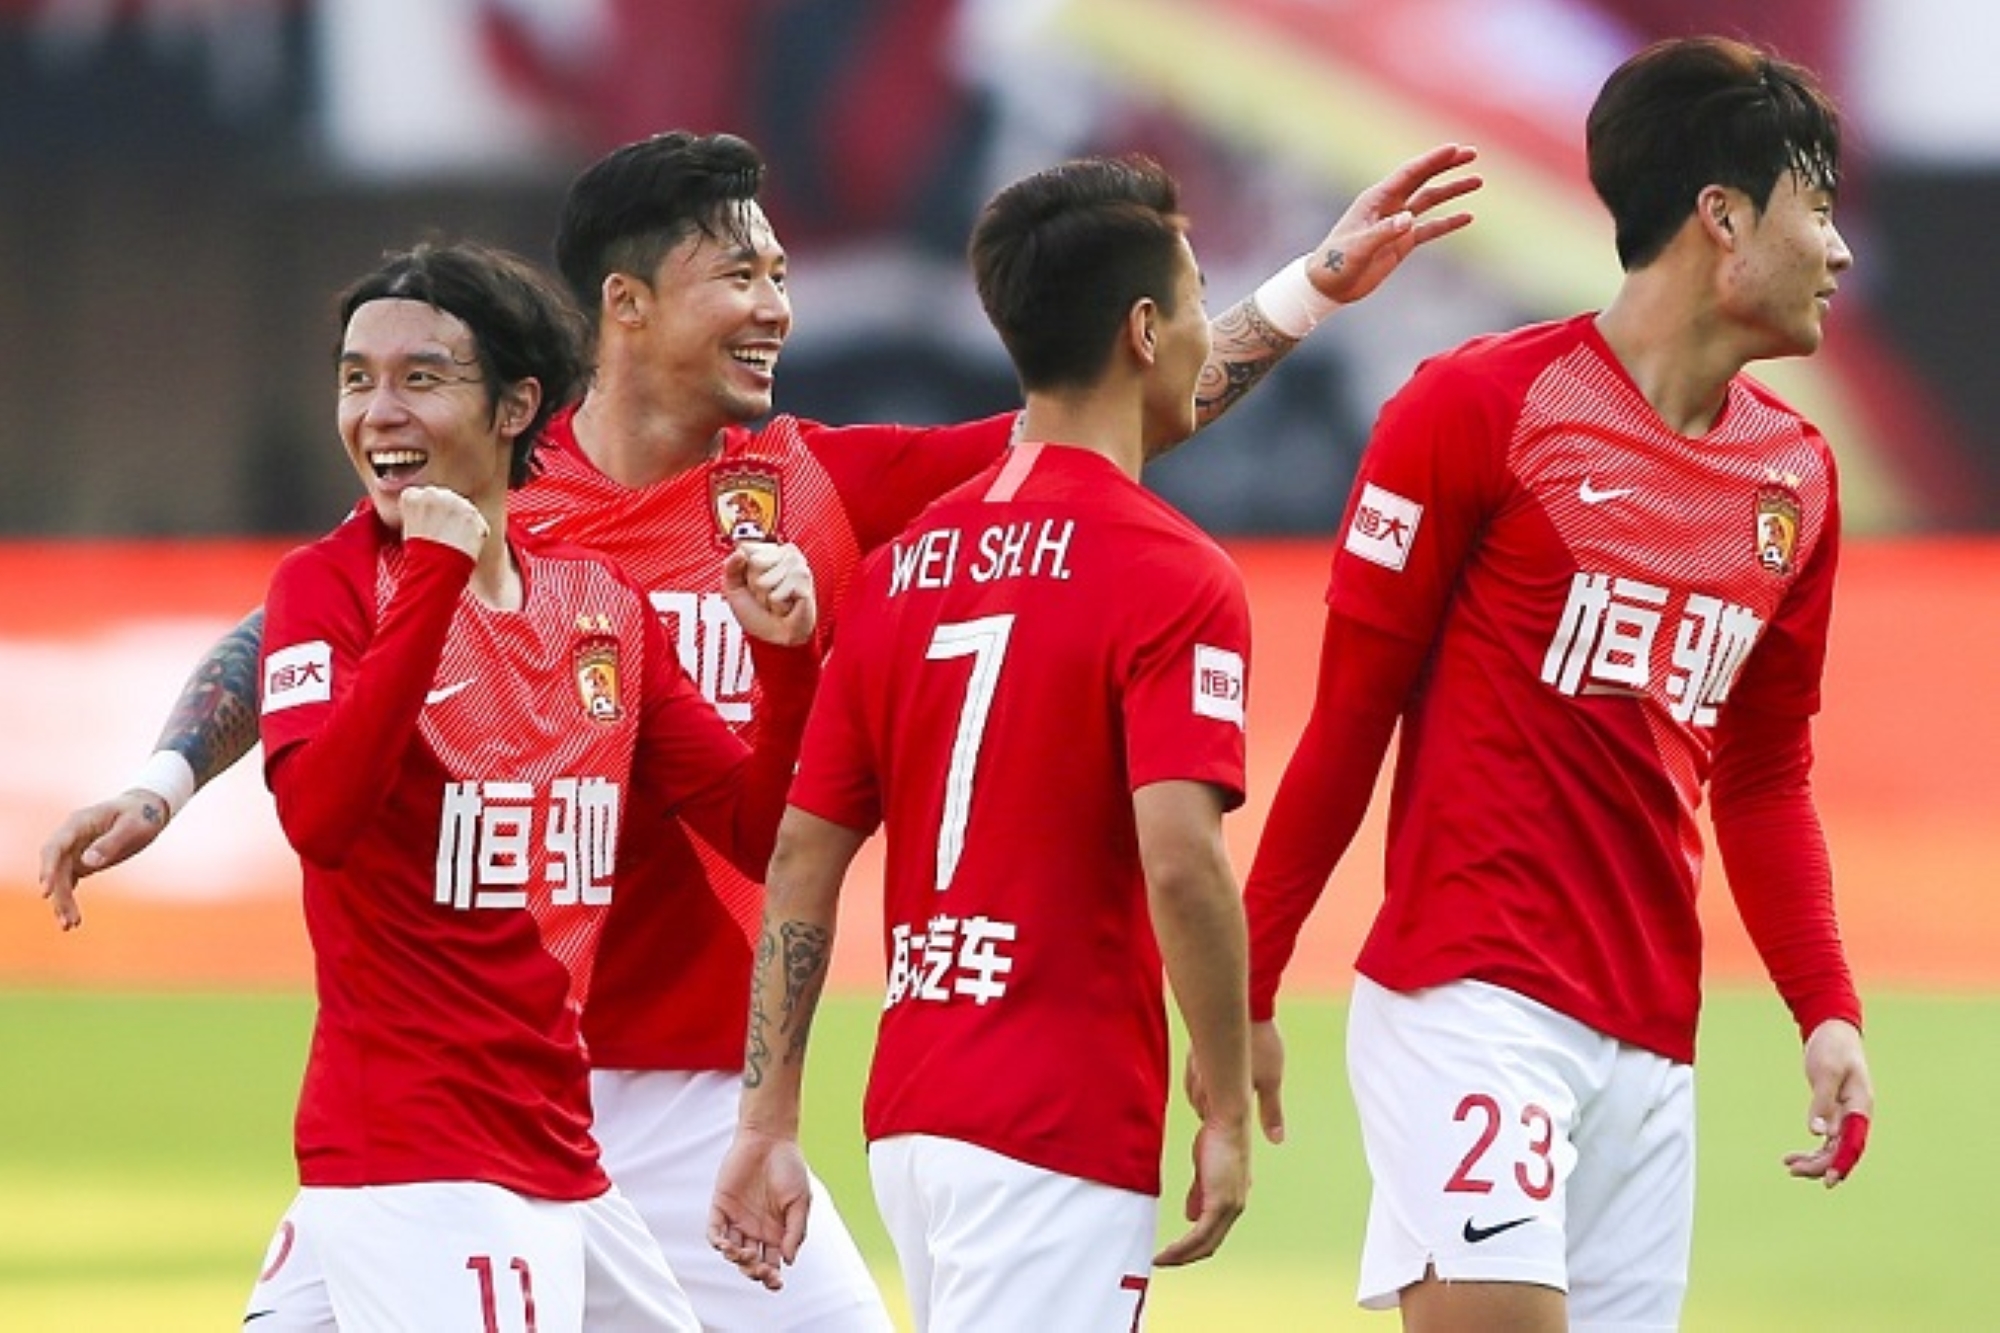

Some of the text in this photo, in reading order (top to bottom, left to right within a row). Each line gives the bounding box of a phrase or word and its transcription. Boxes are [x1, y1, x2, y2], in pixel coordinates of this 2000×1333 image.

[887, 527, 961, 598] WEI
[1355, 506, 1409, 548] 恒大
[270, 661, 325, 695] 恒大
[1540, 572, 1765, 727] 恒驰
[925, 613, 1016, 891] 7
[434, 776, 619, 910] 恒驰
[1443, 1093, 1555, 1201] 23
[466, 1256, 538, 1333] 11
[1120, 1274, 1149, 1333] 7
